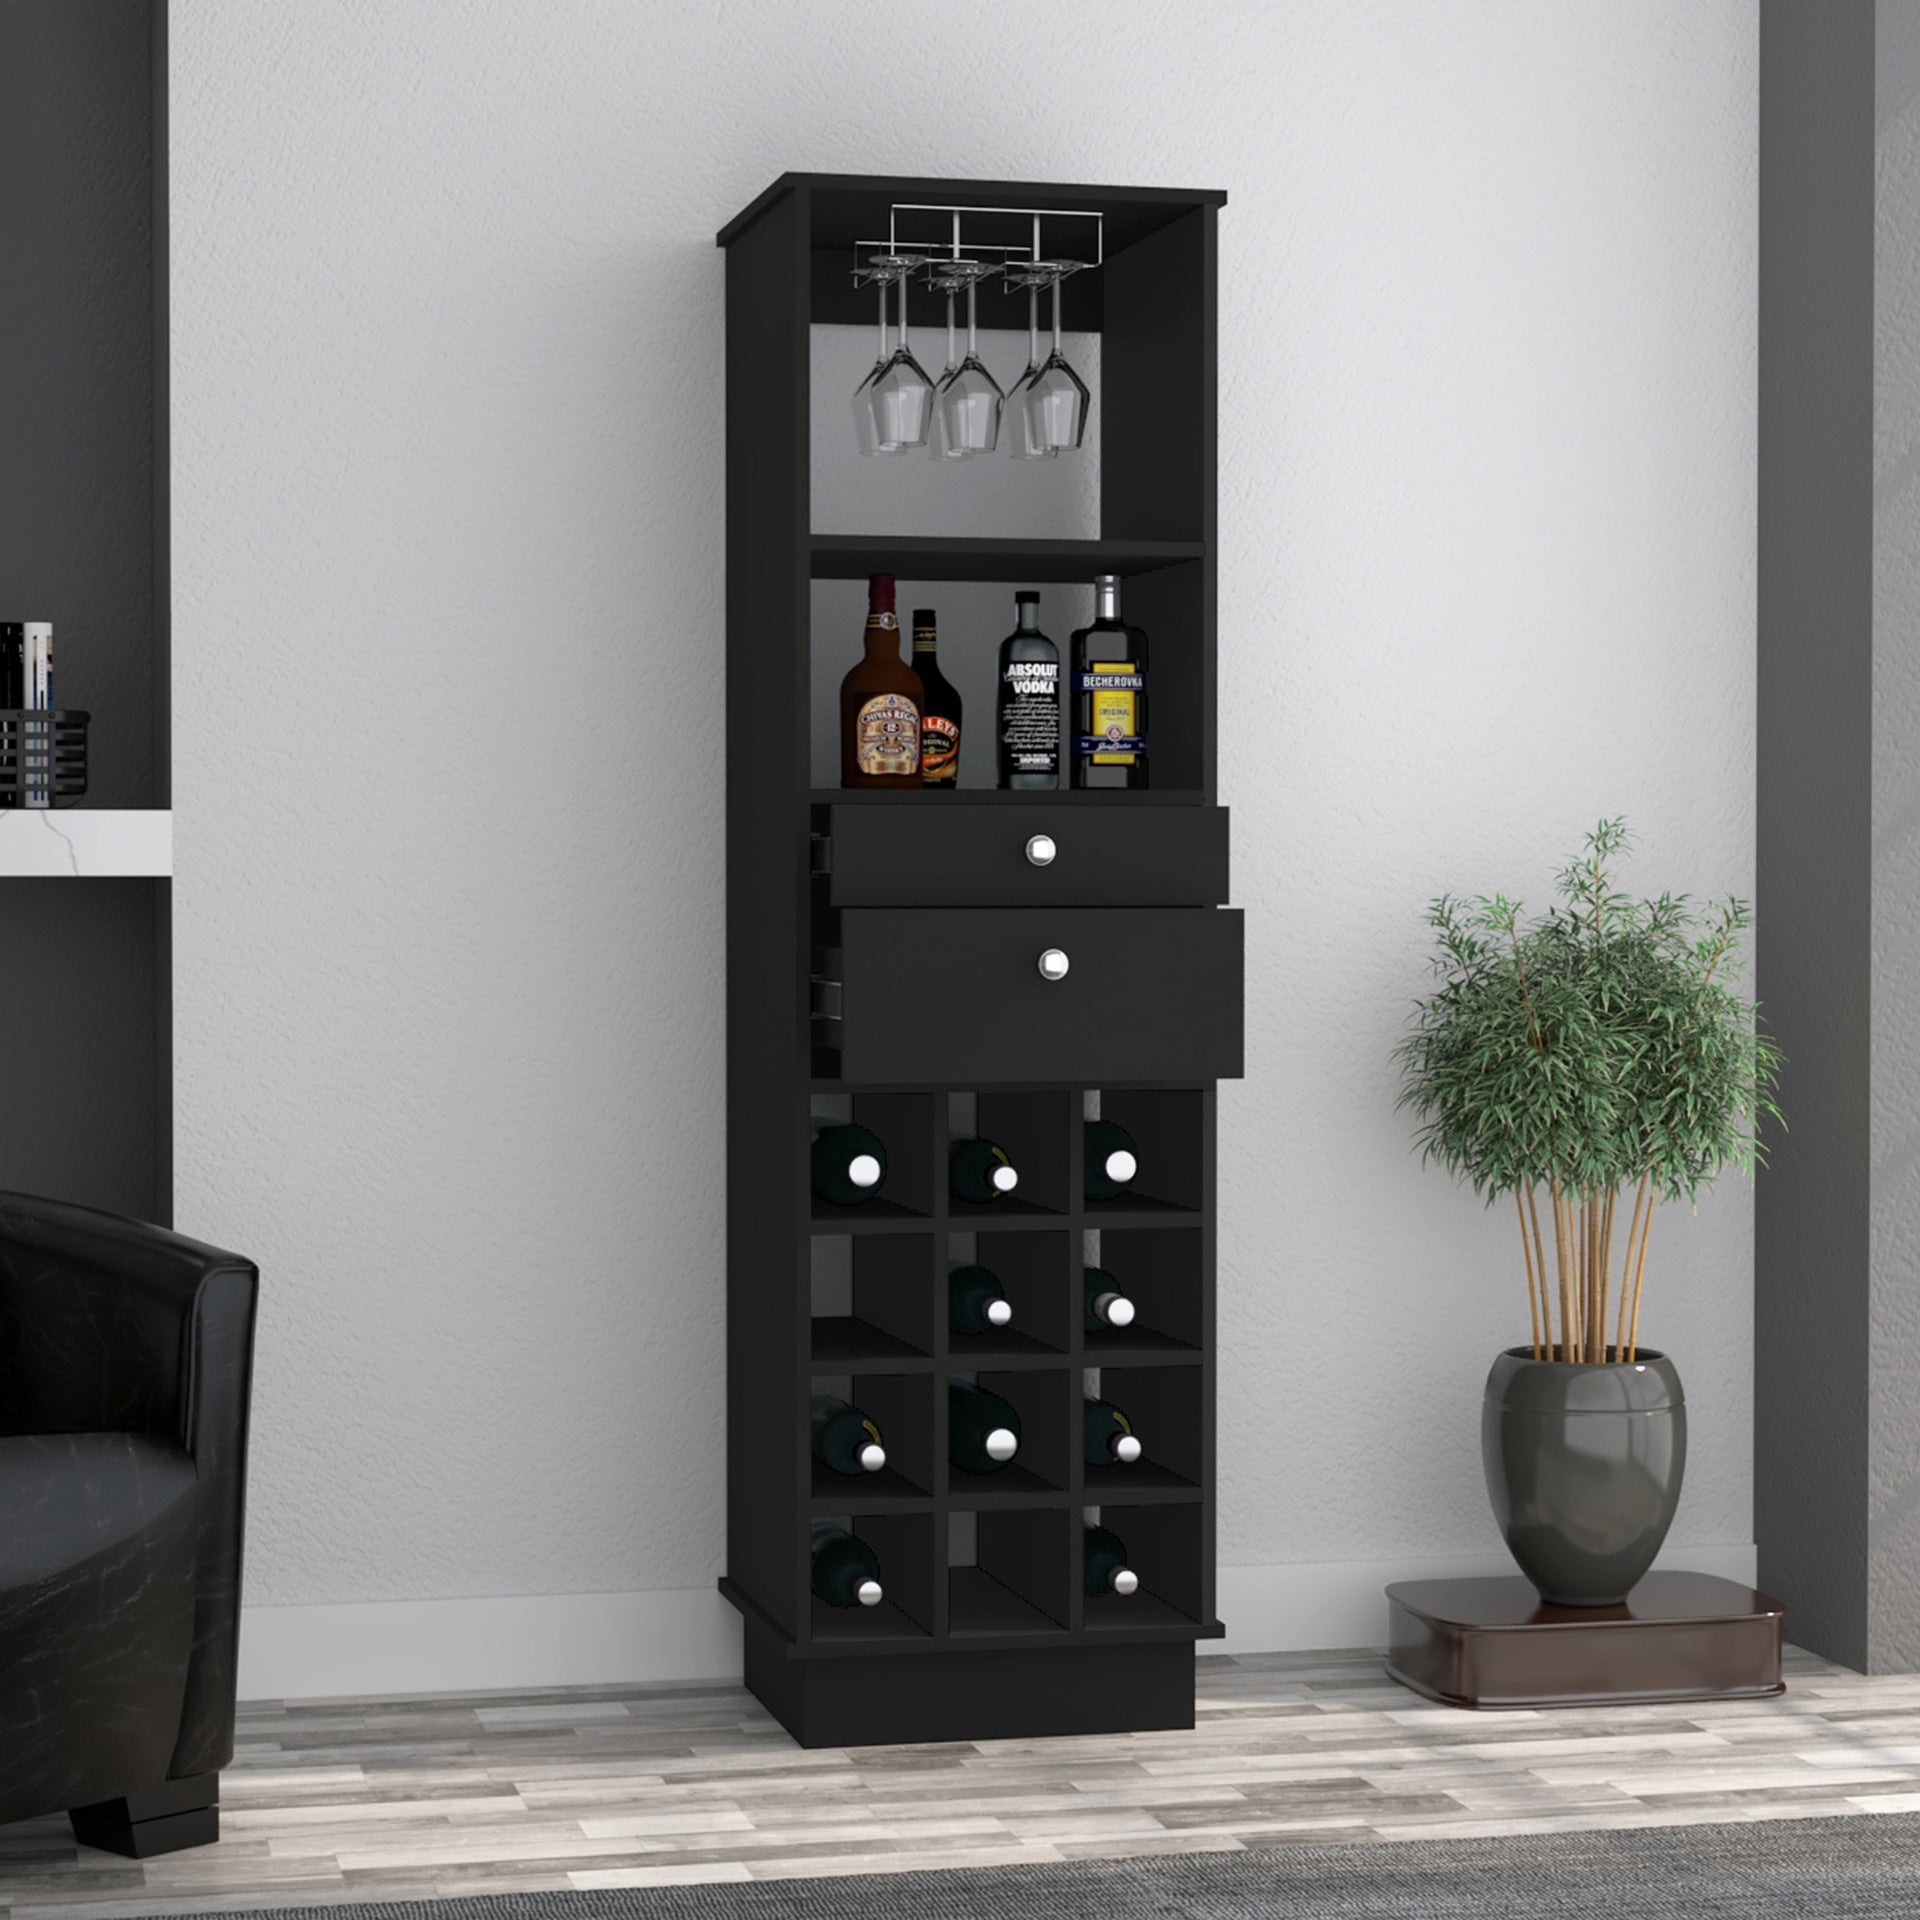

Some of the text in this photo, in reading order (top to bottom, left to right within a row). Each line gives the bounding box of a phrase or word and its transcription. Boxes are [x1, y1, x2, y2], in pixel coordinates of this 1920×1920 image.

[1008, 664, 1058, 676] ABSOLUT
[1013, 681, 1055, 694] VODKA
[1083, 676, 1143, 687] BECHEROVKA
[861, 711, 893, 724] CHIVAS
